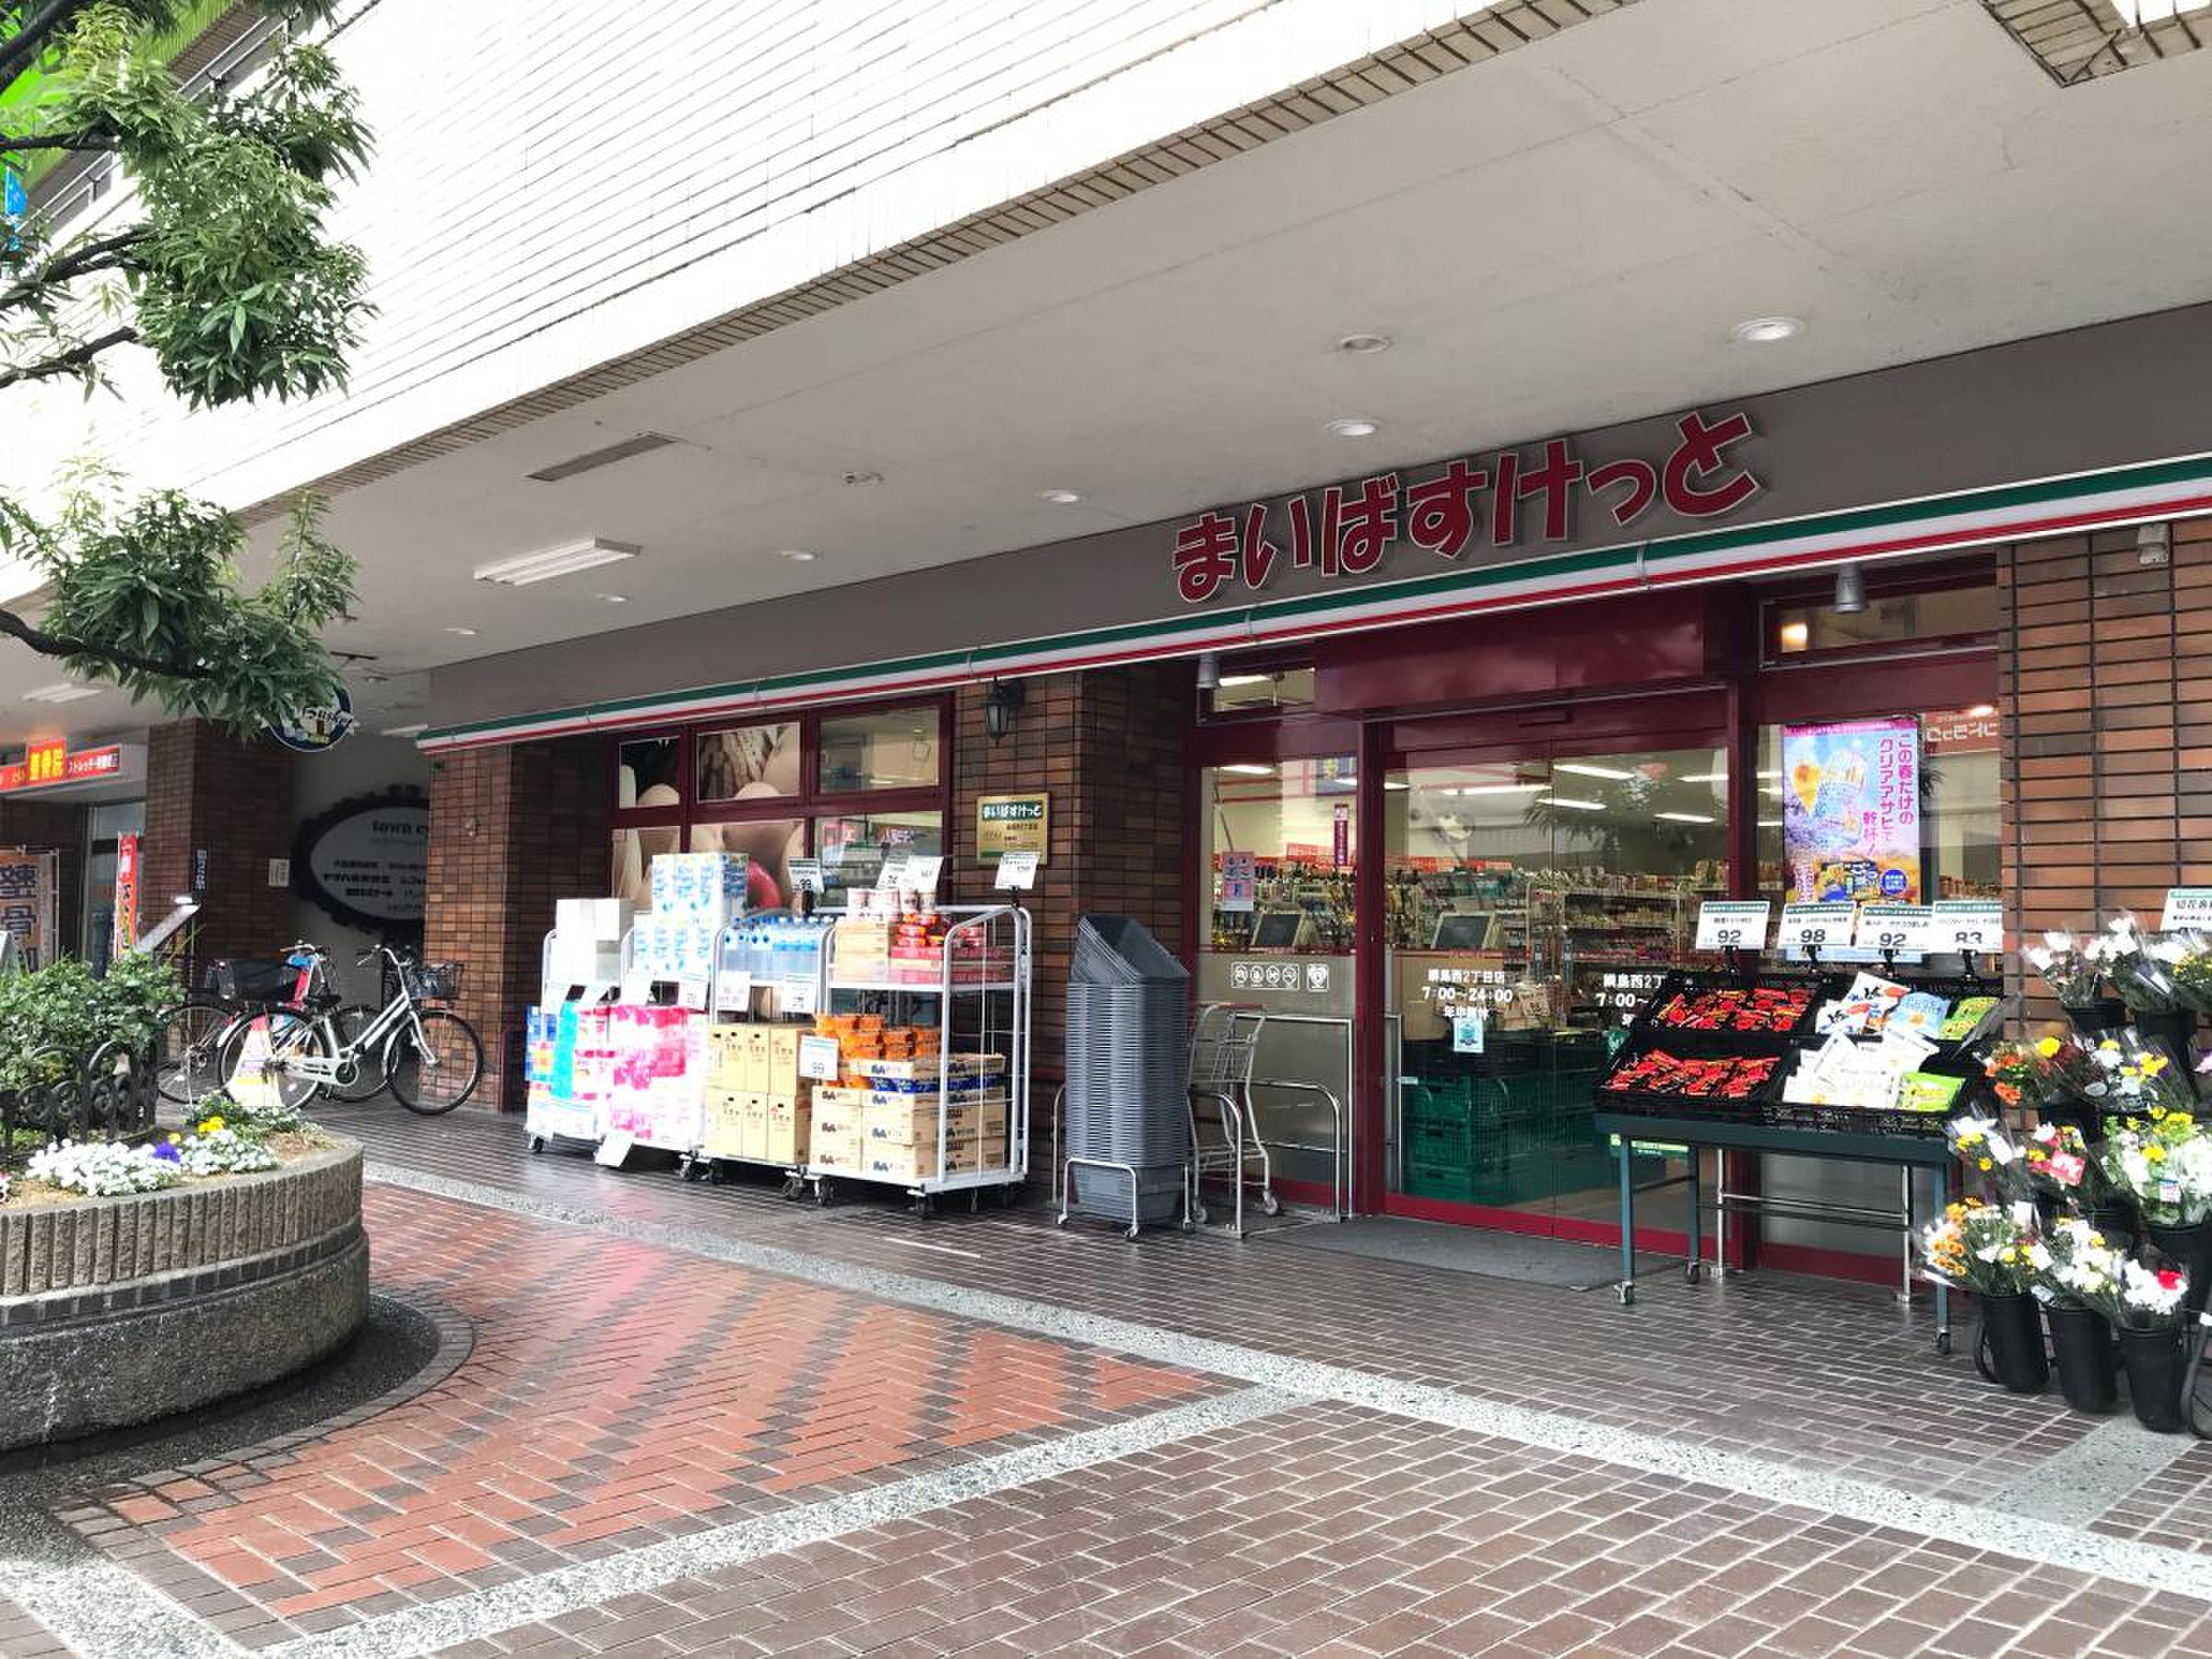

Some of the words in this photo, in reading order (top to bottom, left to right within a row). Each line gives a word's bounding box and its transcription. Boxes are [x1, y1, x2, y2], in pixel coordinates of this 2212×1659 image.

[1172, 411, 1759, 603] まいばすけっと
[1898, 733, 1914, 825] この春だけの
[1717, 929, 1742, 944] 92
[1800, 929, 1826, 943] 98
[1879, 933, 1907, 947] 92
